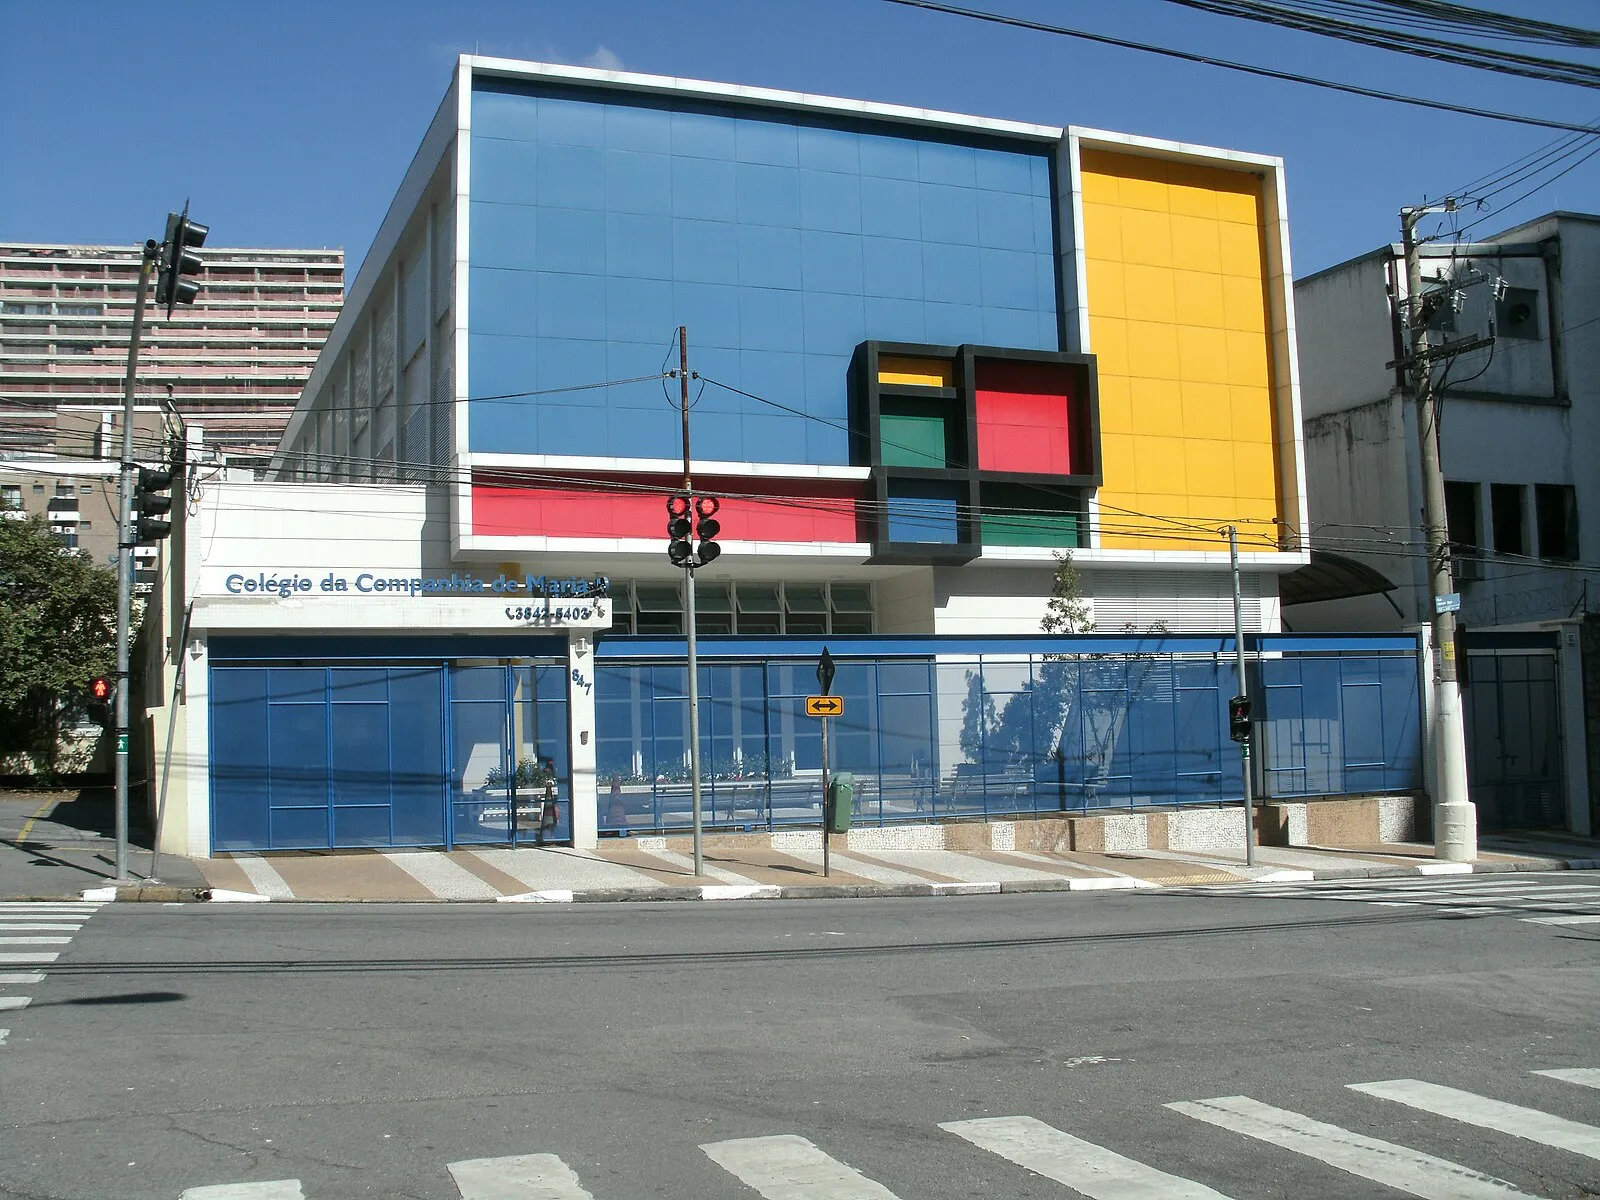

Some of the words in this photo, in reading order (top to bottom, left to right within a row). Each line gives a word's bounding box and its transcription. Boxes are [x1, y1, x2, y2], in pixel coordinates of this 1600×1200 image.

[226, 573, 313, 598] Colégio
[320, 573, 348, 592] da
[355, 573, 484, 597] Companhia
[491, 574, 519, 593] de
[526, 573, 588, 593] Maria
[572, 668, 592, 696] 847
